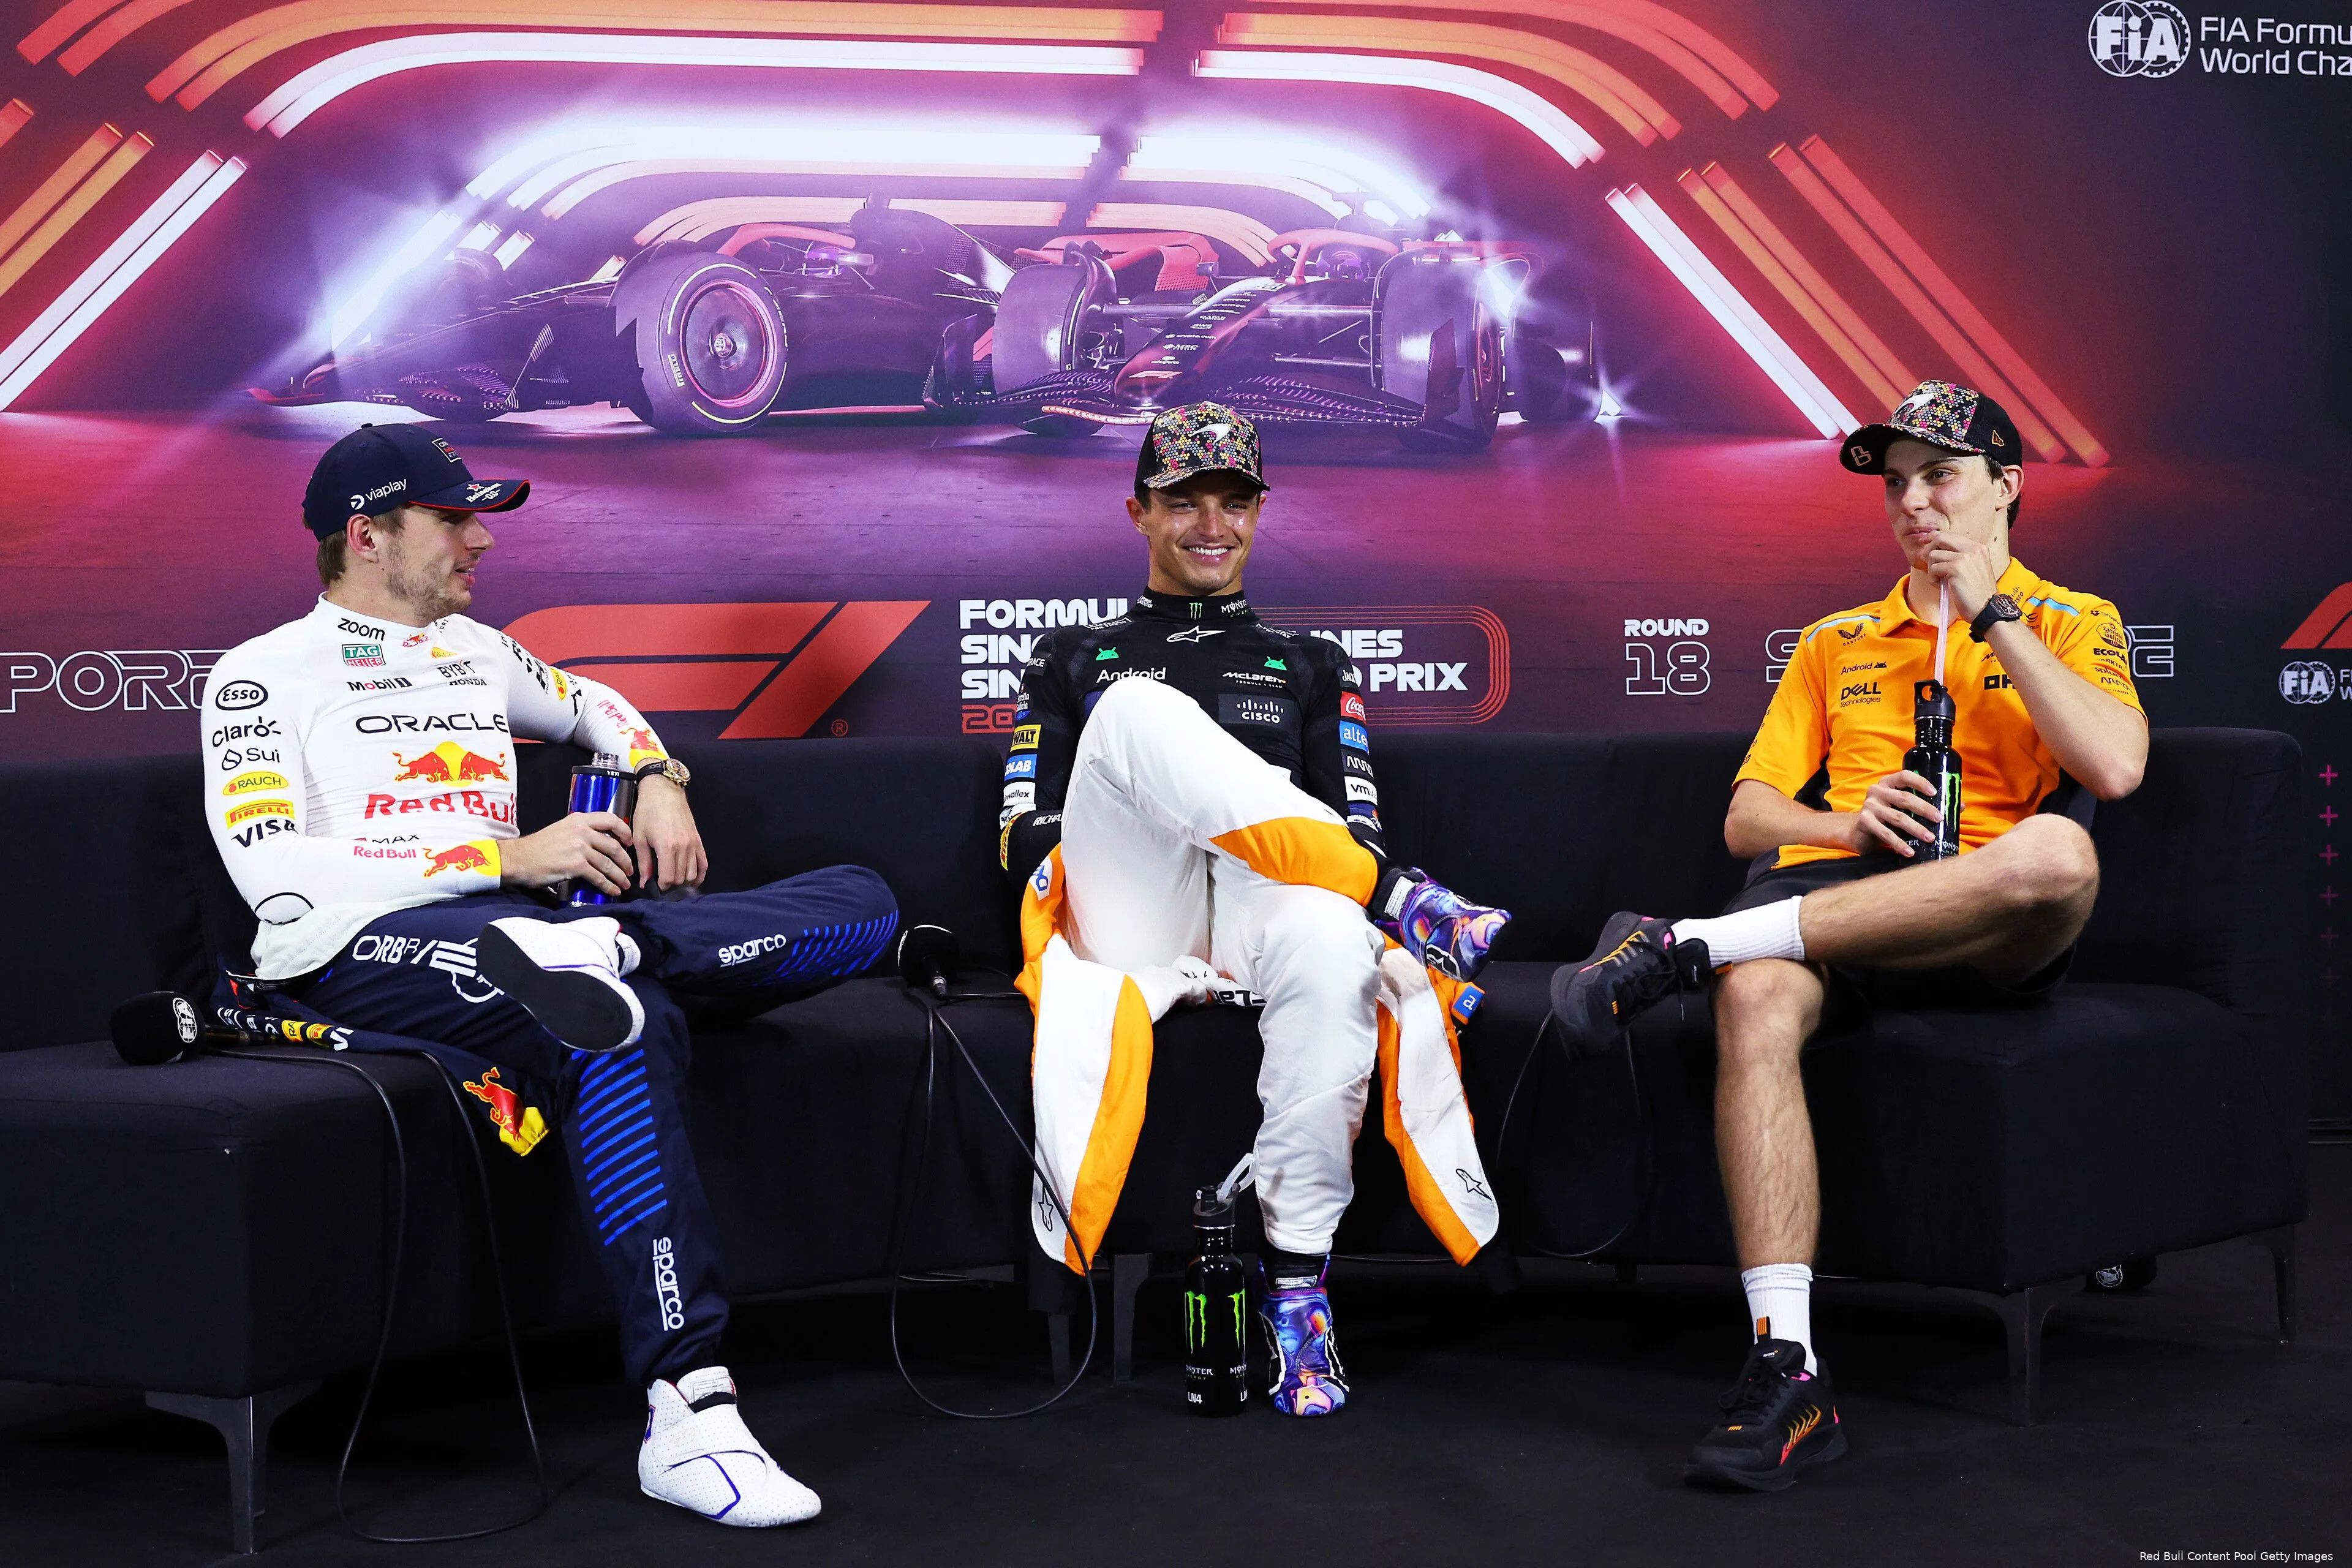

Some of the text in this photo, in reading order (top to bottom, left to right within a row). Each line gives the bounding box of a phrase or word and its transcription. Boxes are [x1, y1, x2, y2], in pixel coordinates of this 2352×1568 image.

[2201, 17, 2250, 43] FIA
[2200, 48, 2290, 75] World
[366, 479, 407, 502] viaplay
[337, 618, 385, 641] zoom
[1624, 618, 1709, 636] ROUND
[345, 646, 380, 658] TAG
[960, 633, 1046, 664] SIN
[1222, 672, 1286, 684] McLaren
[1370, 662, 1468, 692] PRIX
[1626, 641, 1711, 695] 18
[1841, 662, 1873, 675] Android
[347, 679, 396, 691] Mobil
[1841, 682, 1882, 701] DELL
[1840, 696, 1881, 708] Technologies
[355, 713, 508, 734] ORACLE
[246, 747, 281, 763] Sui
[238, 776, 282, 789] RAUCH
[229, 802, 290, 824] PIRELLI
[364, 793, 455, 819] Red
[372, 834, 420, 845] MAX
[353, 846, 417, 858] Red Bull
[718, 934, 786, 966] sparco
[653, 1237, 685, 1331] sparco
[1188, 1391, 1203, 1404] LN4
